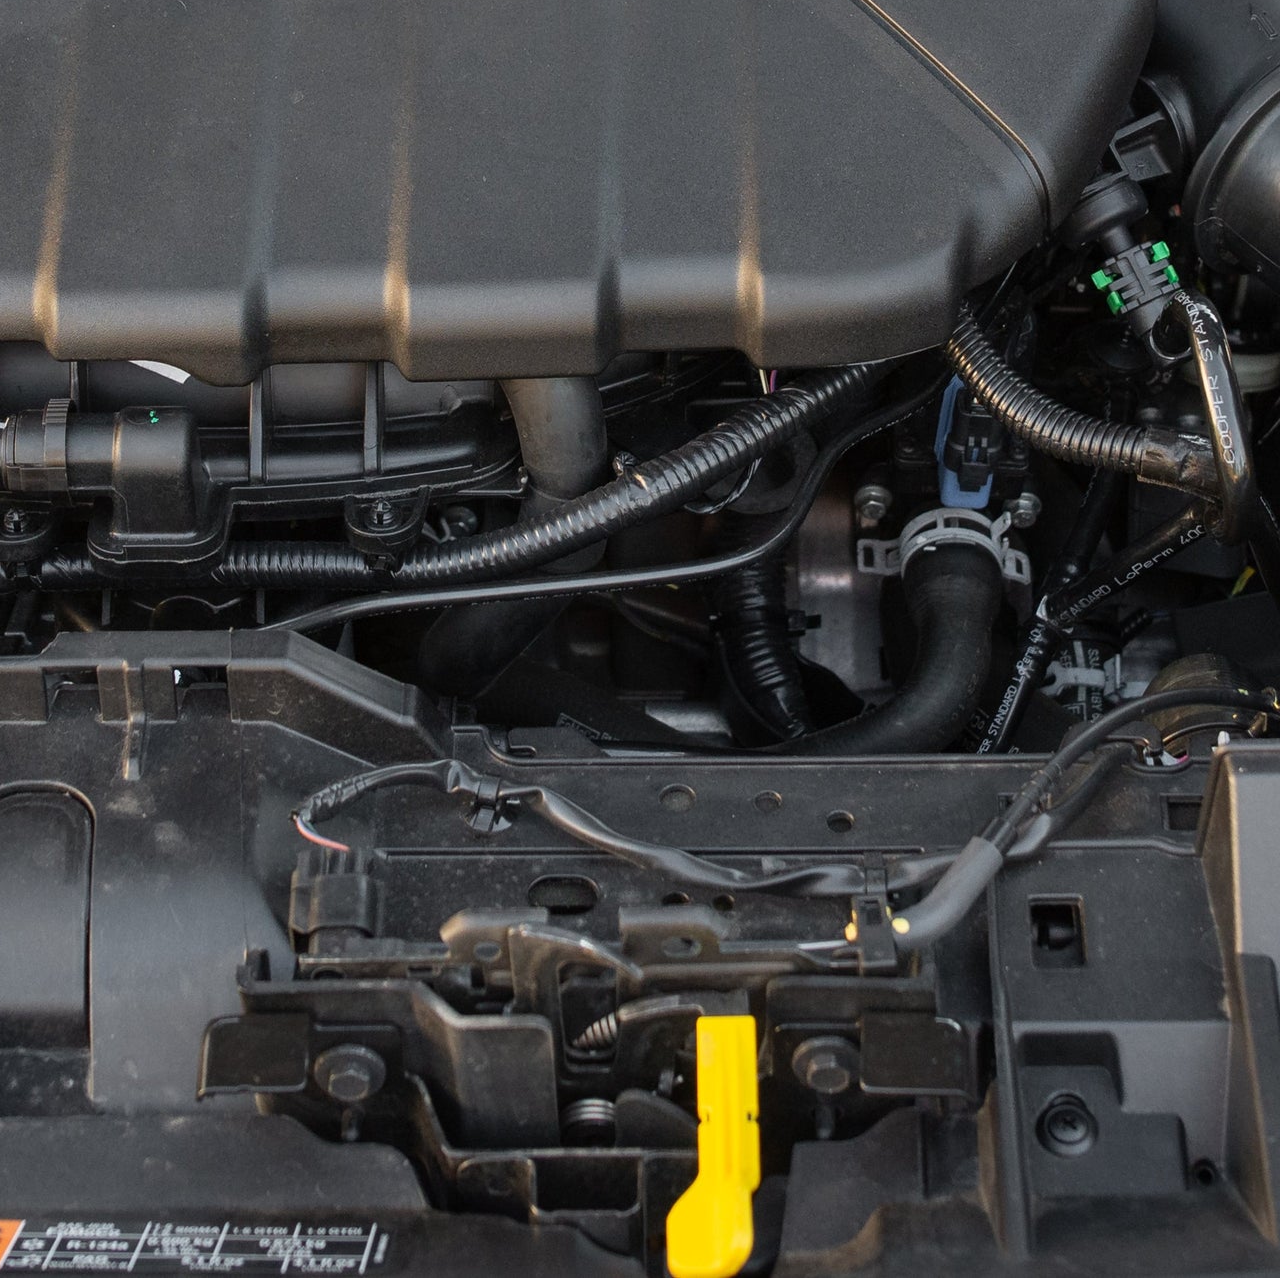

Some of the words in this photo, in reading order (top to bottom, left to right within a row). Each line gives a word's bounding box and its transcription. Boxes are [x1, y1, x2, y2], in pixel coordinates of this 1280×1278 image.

[1174, 288, 1214, 362] STANDARD
[1206, 374, 1236, 465] COOPER
[1059, 584, 1112, 622] STANDARD
[1114, 547, 1175, 587] LoPerm
[987, 685, 1018, 736] STANDARD
